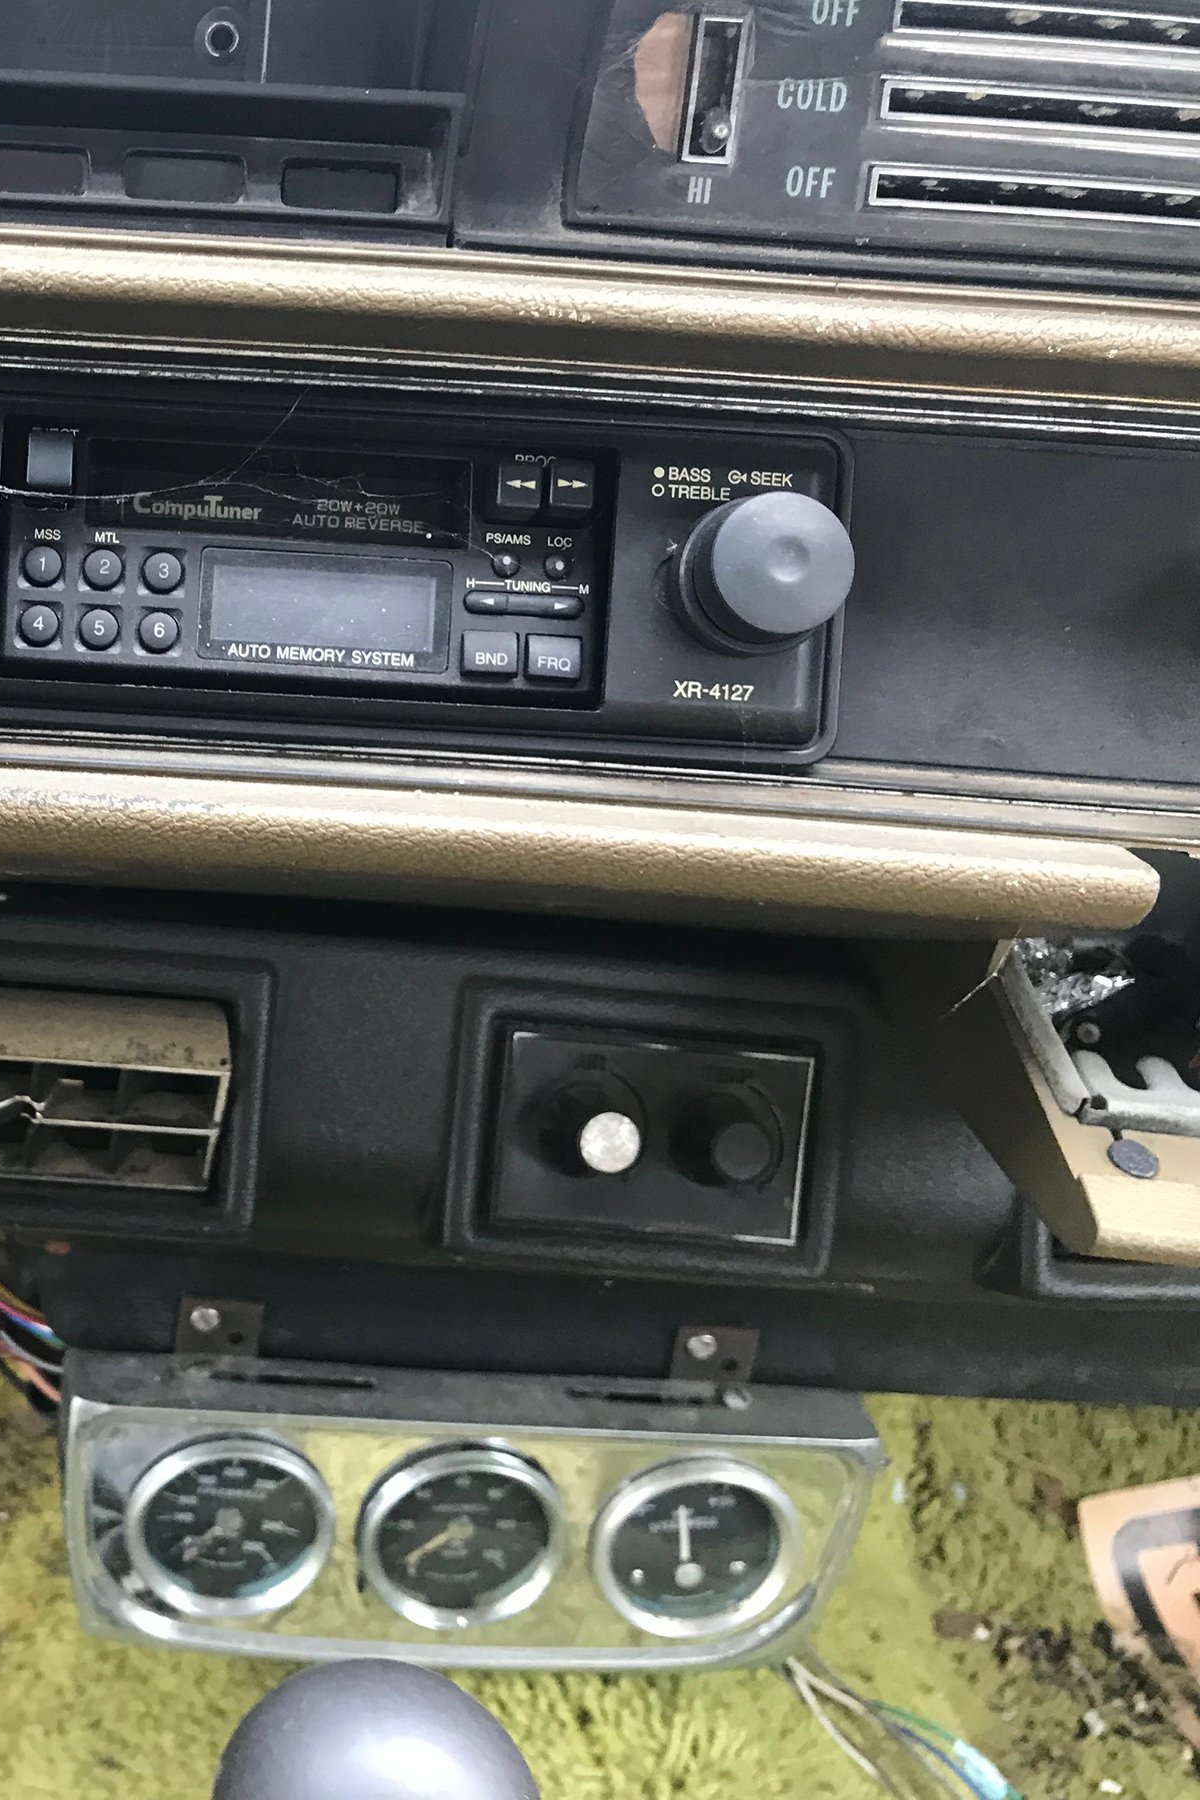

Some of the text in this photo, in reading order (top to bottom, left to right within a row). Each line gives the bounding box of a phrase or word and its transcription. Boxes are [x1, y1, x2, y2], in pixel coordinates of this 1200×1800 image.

[811, 0, 859, 27] OFF
[777, 77, 848, 112] COLD
[687, 177, 712, 204] HI
[786, 166, 836, 199] OFF
[668, 466, 793, 487] BASS SEEK
[669, 484, 731, 501] TREBLE
[133, 492, 263, 521] CompuTuner
[292, 514, 425, 535] AUTO REVERSE
[34, 529, 61, 541] MSS
[94, 531, 120, 544] MTL
[486, 532, 531, 546] PS/AMS
[547, 536, 573, 548] LOC
[39, 557, 46, 571] 1
[99, 559, 110, 574] 2
[158, 563, 169, 579] 3
[466, 578, 590, 595] H TUNING M
[33, 616, 44, 631] 4
[94, 620, 105, 636] 5
[154, 622, 165, 638] 6
[228, 643, 415, 667] AUTO MEMORY SYSTEM
[475, 652, 508, 666] BND
[537, 656, 572, 671] FRQ
[673, 680, 755, 701] XR-4127
